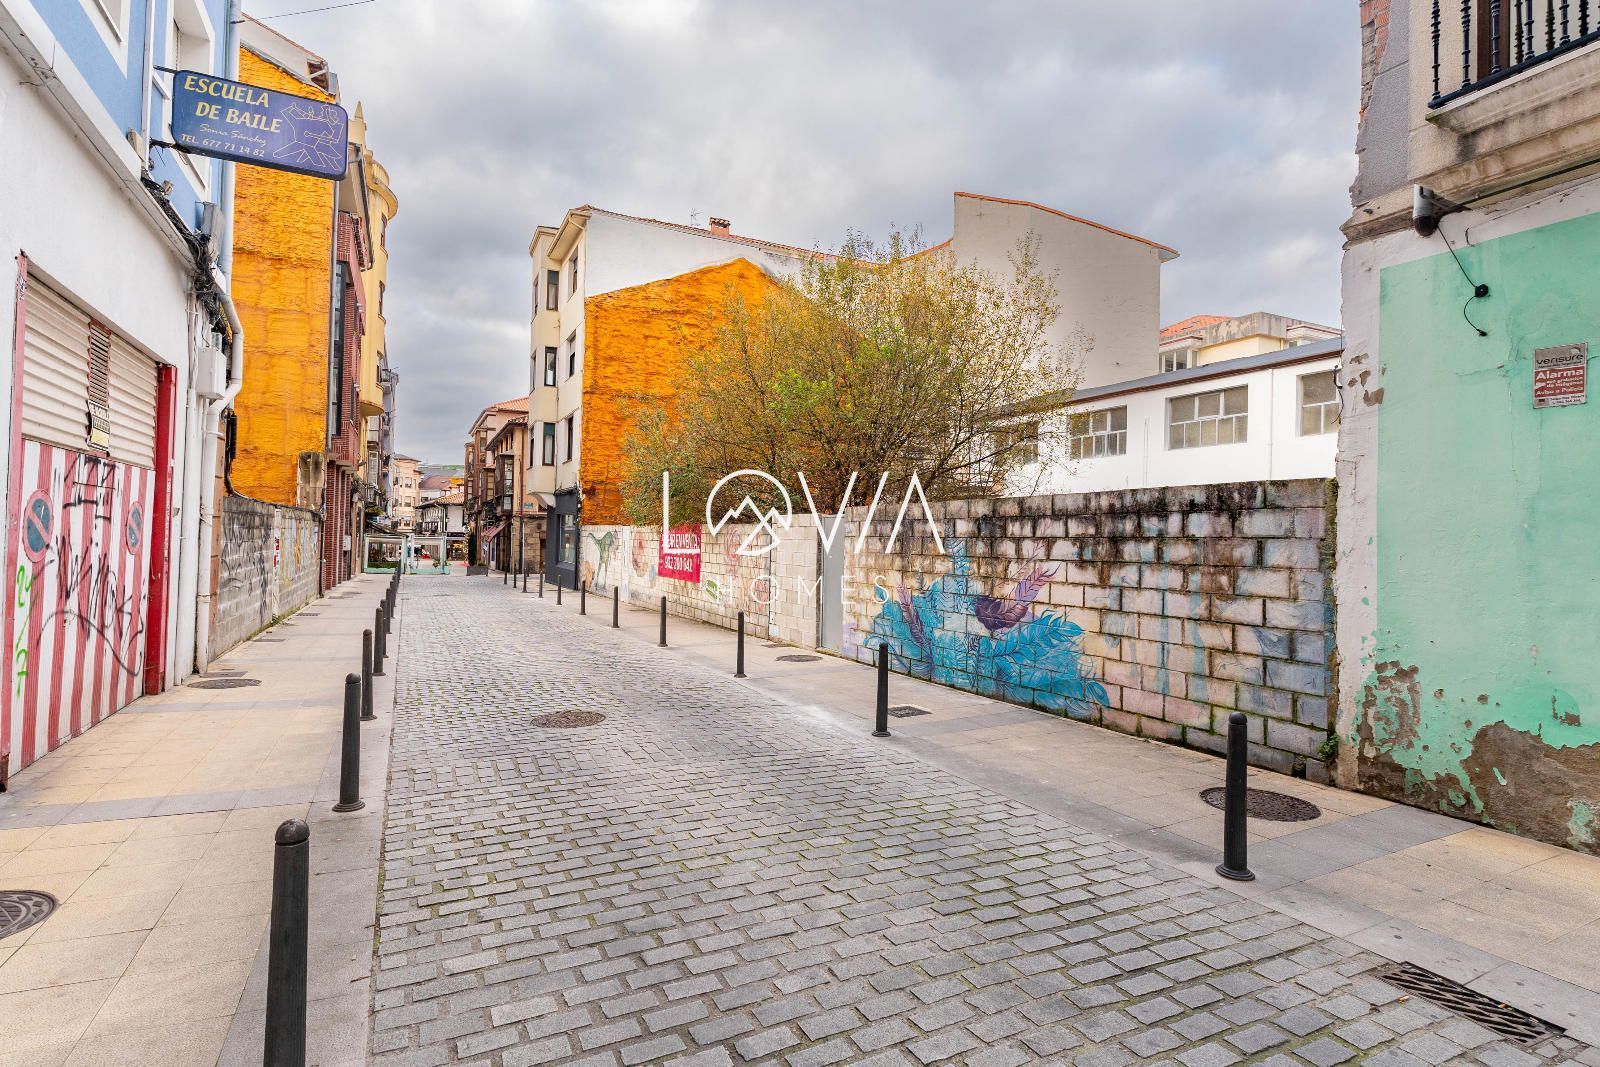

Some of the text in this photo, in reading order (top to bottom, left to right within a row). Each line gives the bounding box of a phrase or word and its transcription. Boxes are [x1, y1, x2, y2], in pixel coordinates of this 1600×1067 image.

[184, 75, 269, 108] ESCUELA
[195, 101, 283, 133] DE BAILE
[202, 138, 222, 148] 677
[224, 142, 235, 152] 71
[239, 145, 250, 154] 14
[252, 148, 265, 157] 82
[1536, 354, 1584, 365] verisure
[1536, 369, 1584, 380] Alarma
